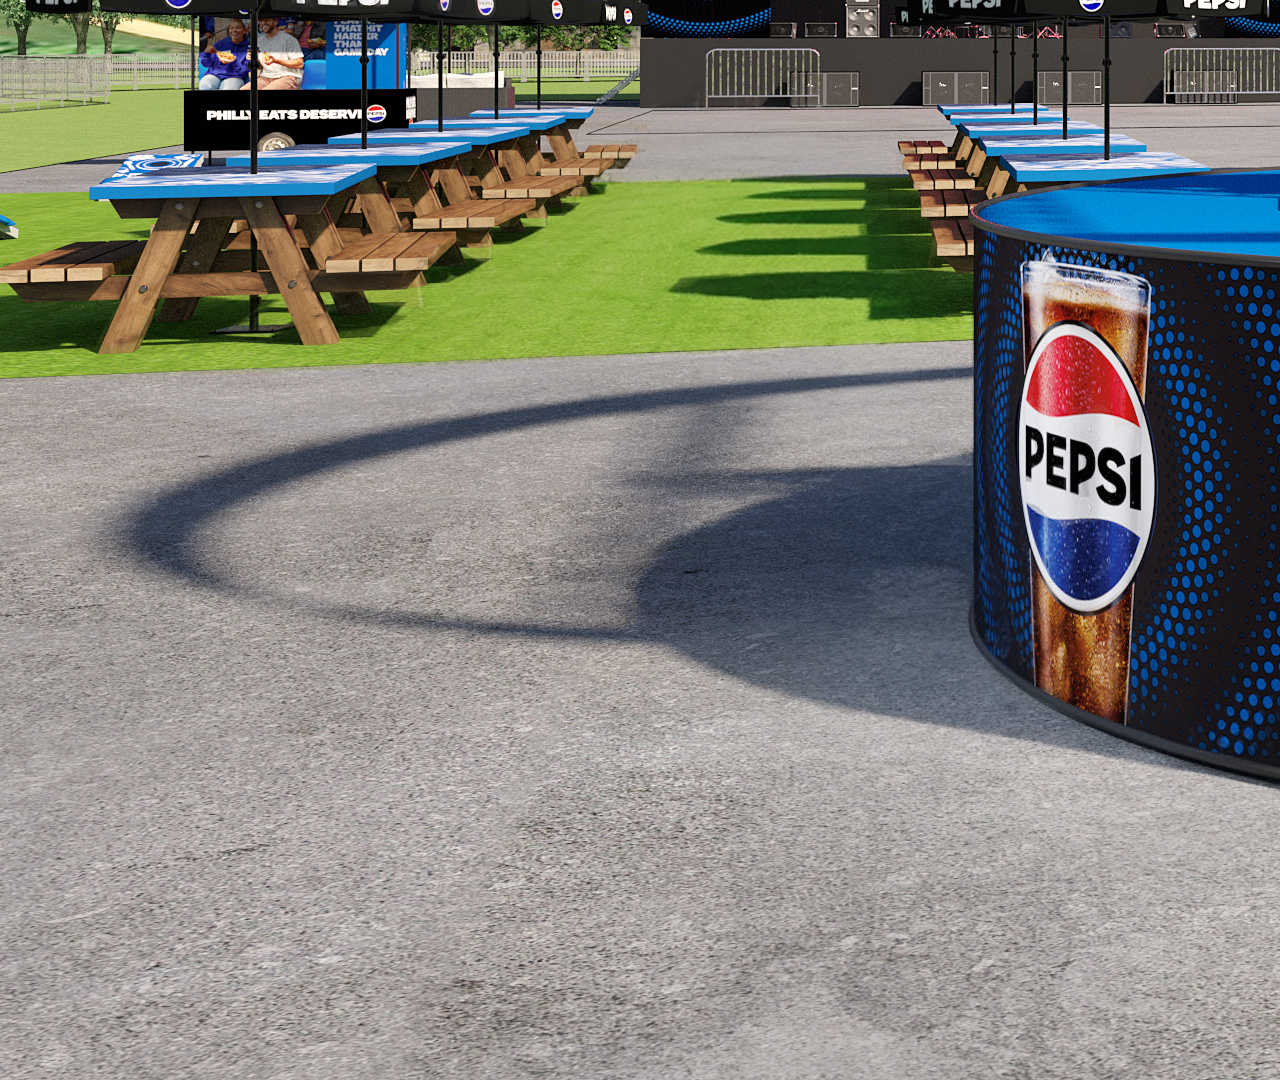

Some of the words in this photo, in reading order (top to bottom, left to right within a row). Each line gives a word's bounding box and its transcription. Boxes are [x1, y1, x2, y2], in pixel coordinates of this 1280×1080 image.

[333, 24, 362, 32] THAT
[366, 24, 384, 32] HIT
[258, 109, 298, 120] EATS
[1025, 424, 1142, 511] PEPSI
